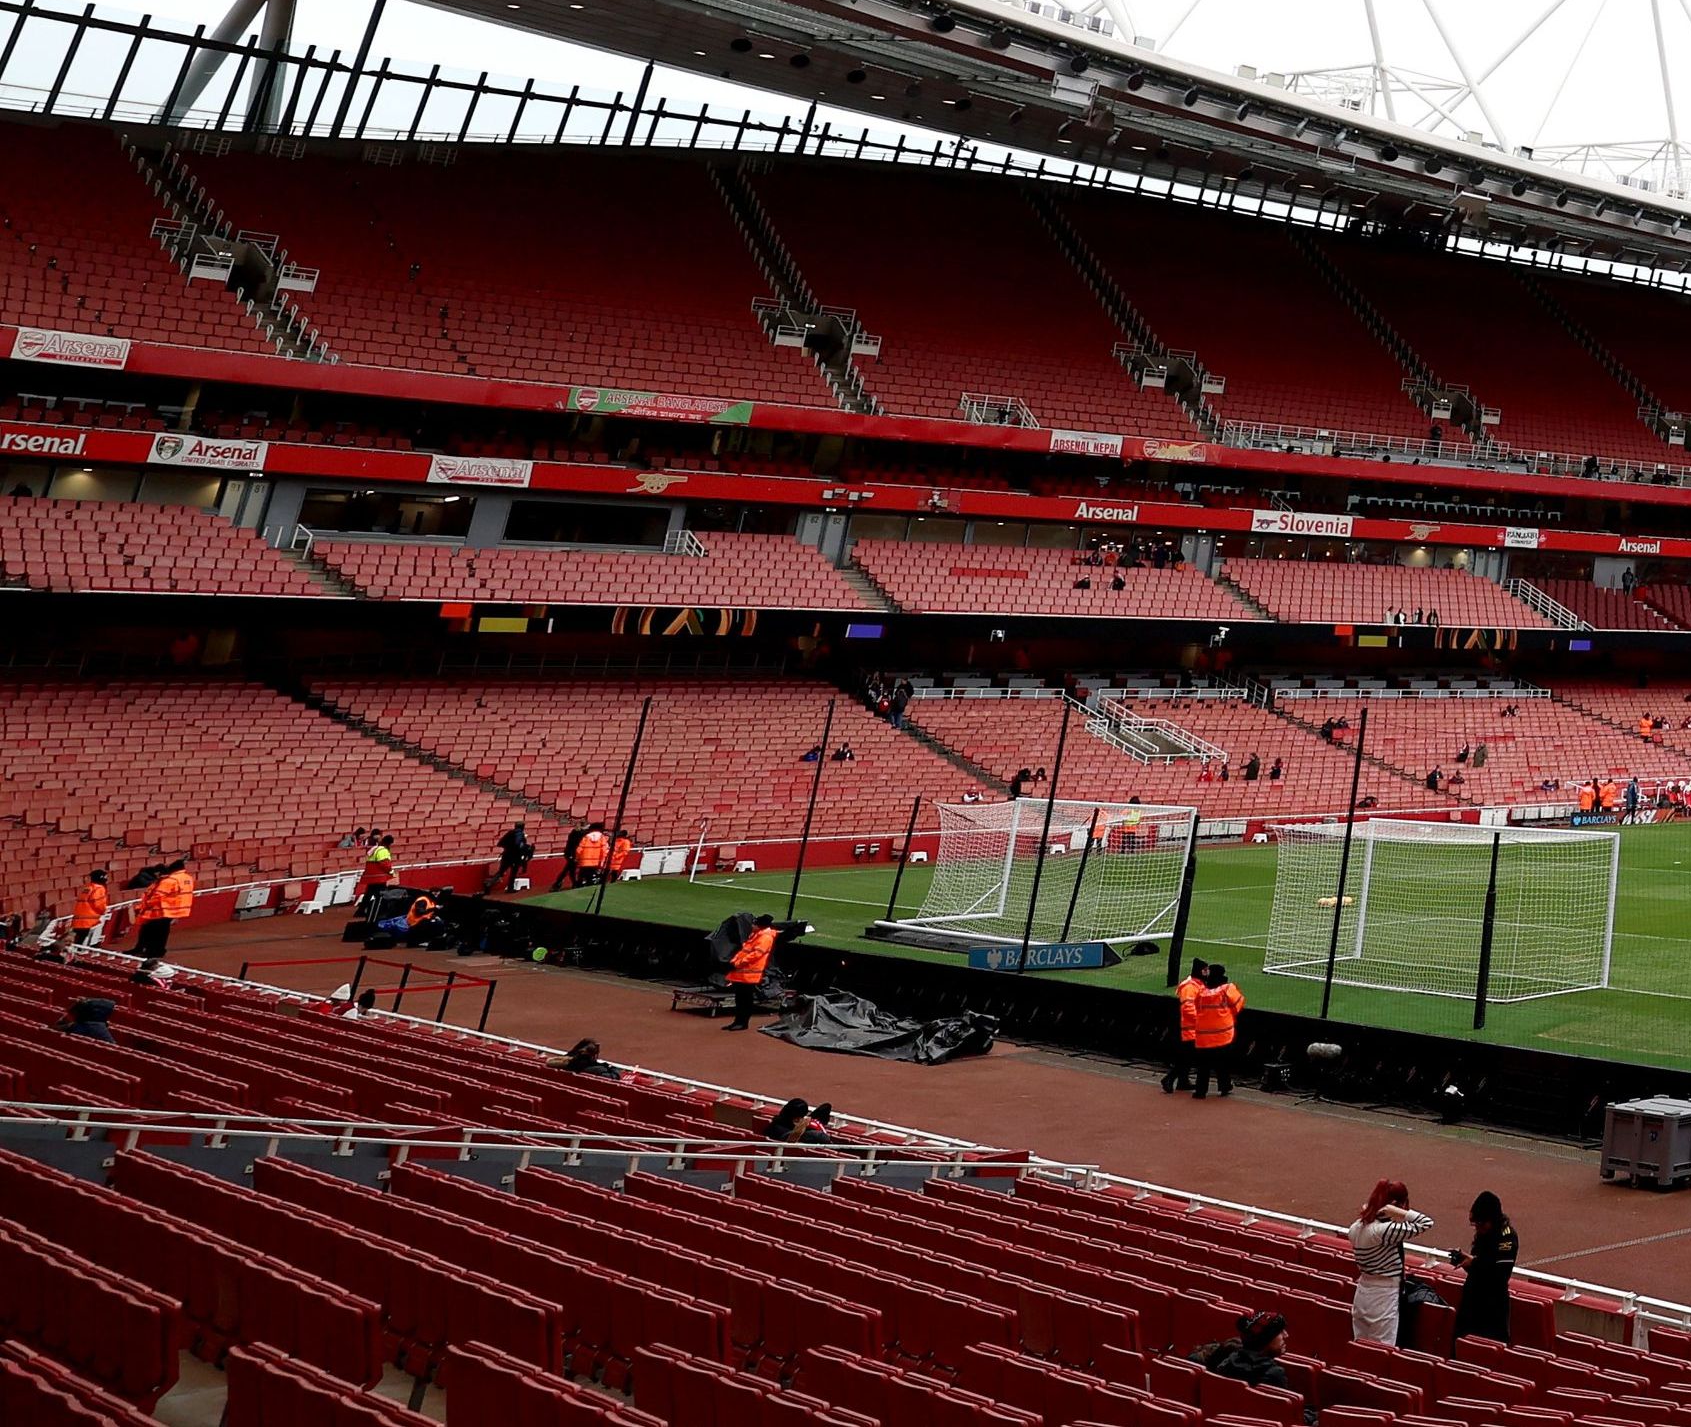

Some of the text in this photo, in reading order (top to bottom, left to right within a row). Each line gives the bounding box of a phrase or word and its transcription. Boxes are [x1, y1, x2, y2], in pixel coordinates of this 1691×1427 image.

[44, 333, 127, 359] Arsenal
[605, 392, 728, 413] ARSENAL BANGLADESH
[0, 432, 86, 456] rsenal
[188, 439, 260, 460] Arsenal
[1053, 439, 1119, 455] ARSENAL NEPAL
[455, 460, 526, 479] Arsenal
[1074, 502, 1138, 521] Arsenal
[1279, 513, 1348, 535] Slovenia
[1618, 538, 1660, 554] Arsenal
[1582, 815, 1617, 824] BARCLAYS
